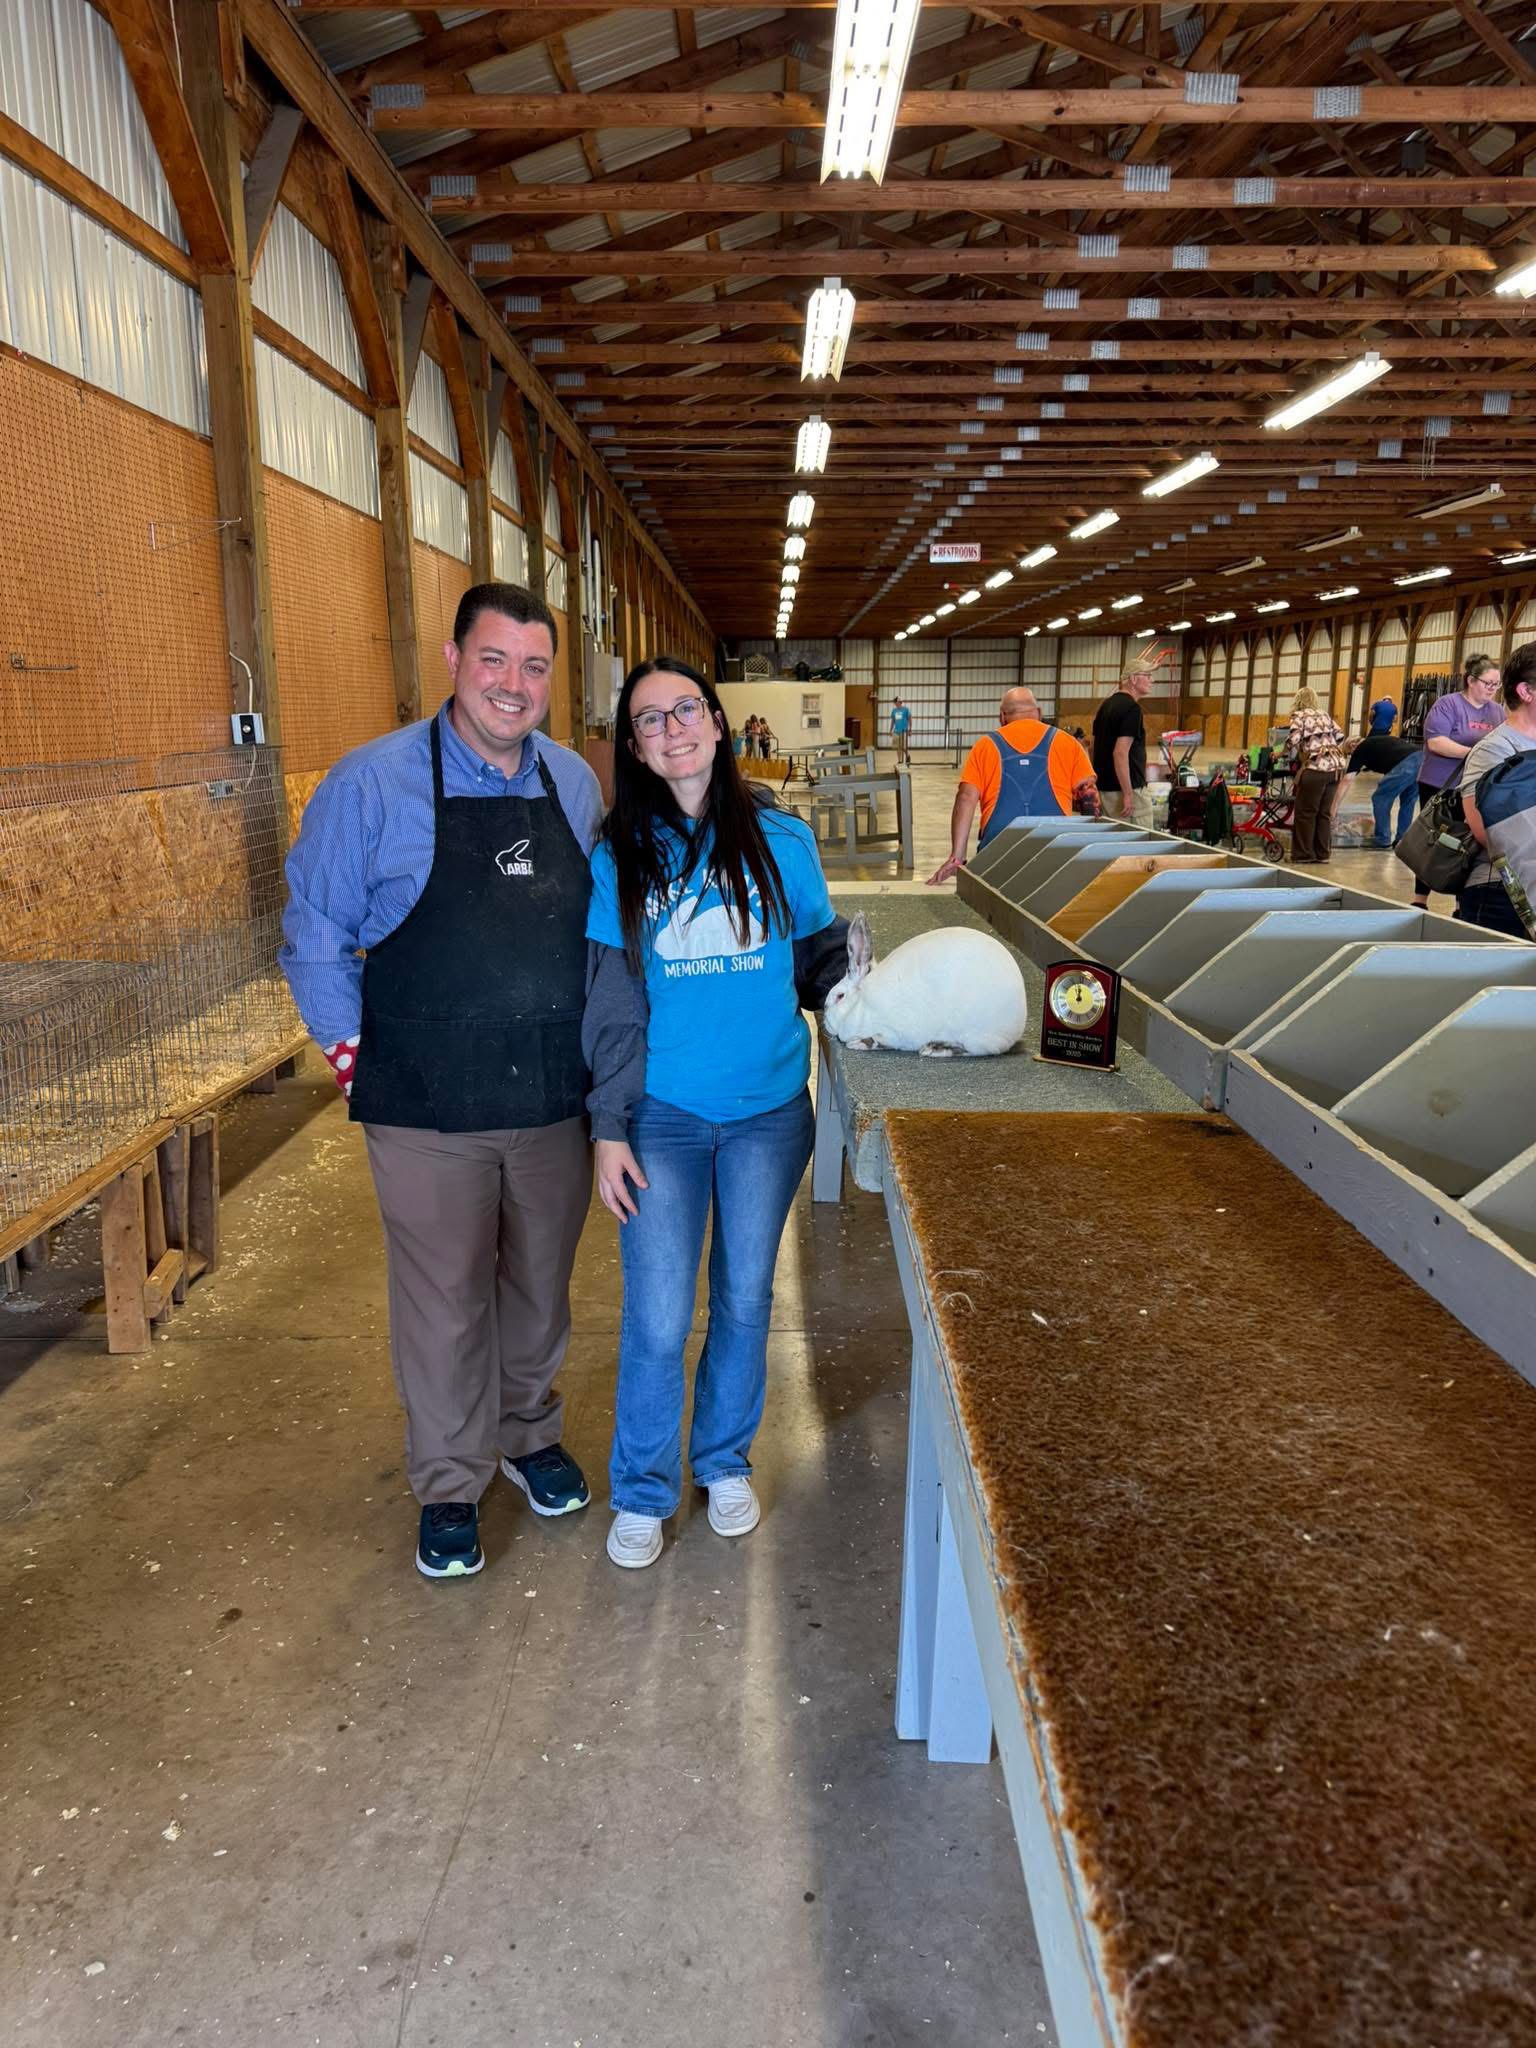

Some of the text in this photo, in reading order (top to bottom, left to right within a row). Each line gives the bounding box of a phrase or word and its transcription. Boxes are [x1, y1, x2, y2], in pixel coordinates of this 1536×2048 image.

[938, 546, 978, 558] RESTROOMS
[664, 954, 765, 978] MEMORIAL SHOW
[1047, 1037, 1102, 1053] BEST IN SHOW
